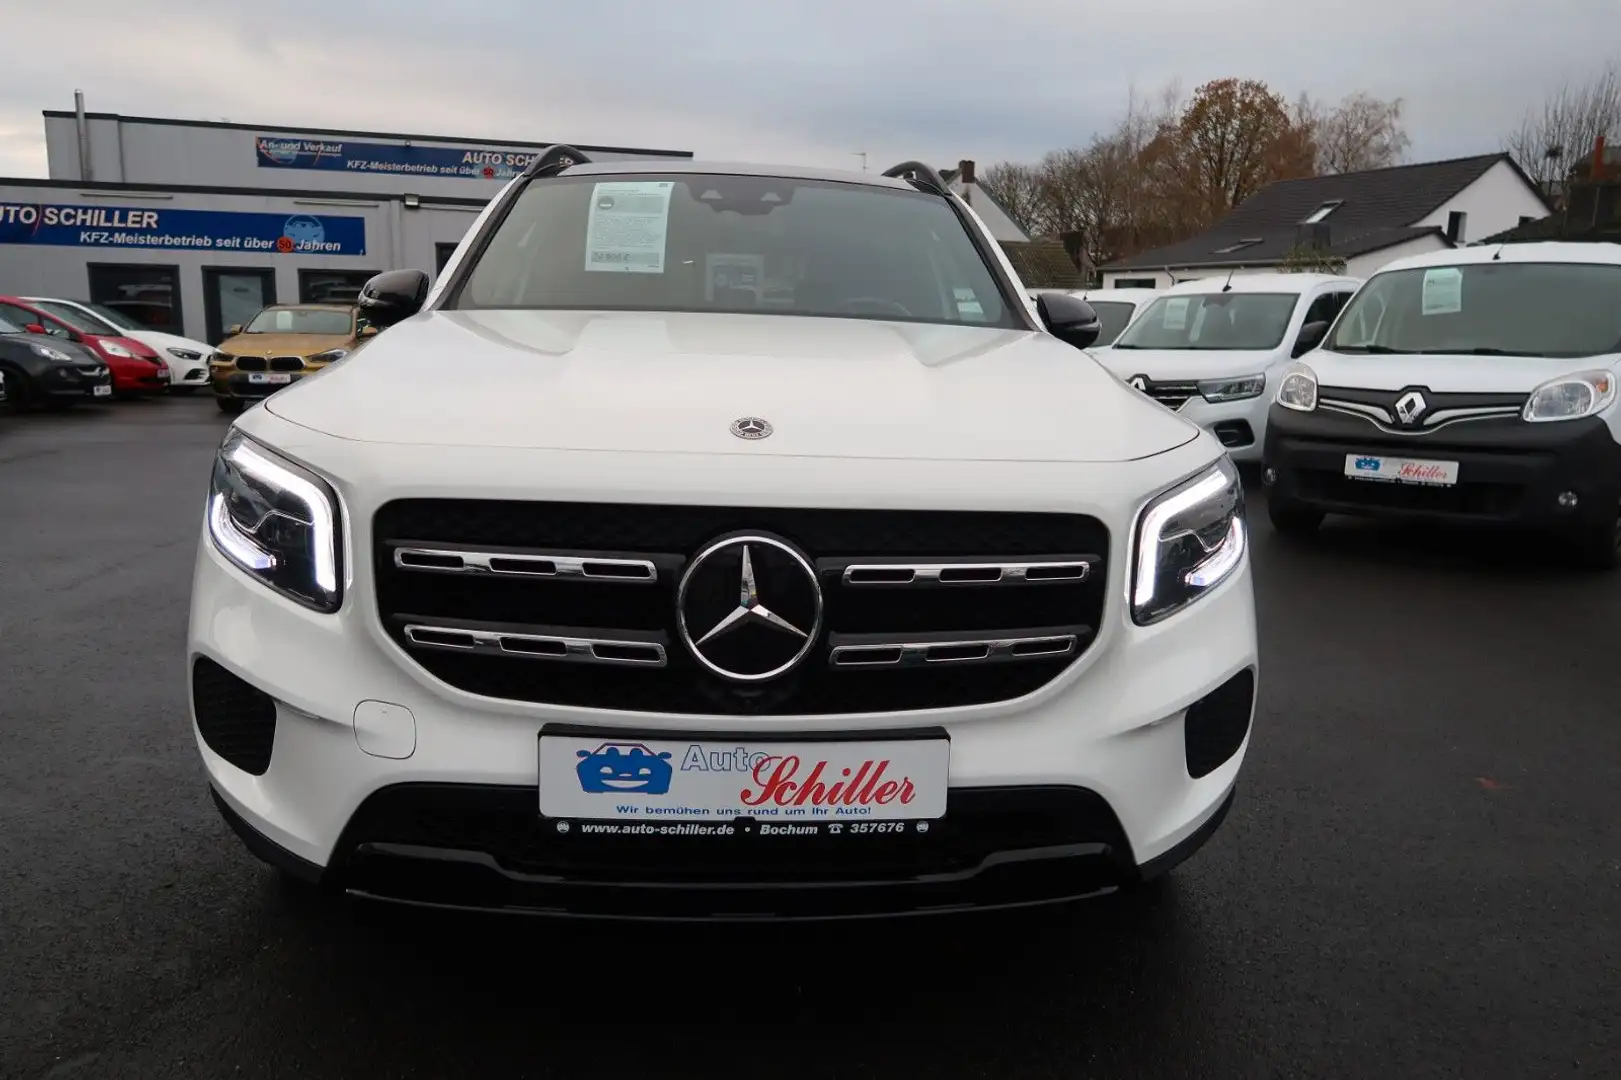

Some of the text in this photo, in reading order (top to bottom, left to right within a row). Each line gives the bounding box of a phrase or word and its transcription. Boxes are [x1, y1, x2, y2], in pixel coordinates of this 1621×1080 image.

[281, 141, 300, 151] und
[303, 142, 342, 153] Verkauf
[462, 151, 502, 165] AUTO
[346, 159, 438, 173] KFZ-Meisterbetrieb
[440, 165, 457, 174] seit
[460, 166, 480, 175] über
[44, 207, 158, 229] SCHILLER
[80, 231, 341, 251] KFZ-Meisterbetrieb seit über 50 Jahren
[680, 744, 916, 806] Auto Schiller
[616, 805, 639, 814] Wir
[645, 806, 710, 815] bemühen
[716, 808, 741, 816] uns
[748, 806, 779, 815] rund
[812, 806, 828, 815] Ihr
[835, 806, 871, 815] Auto!
[581, 822, 905, 835] www.auto-schiller.de Bochum 357676
